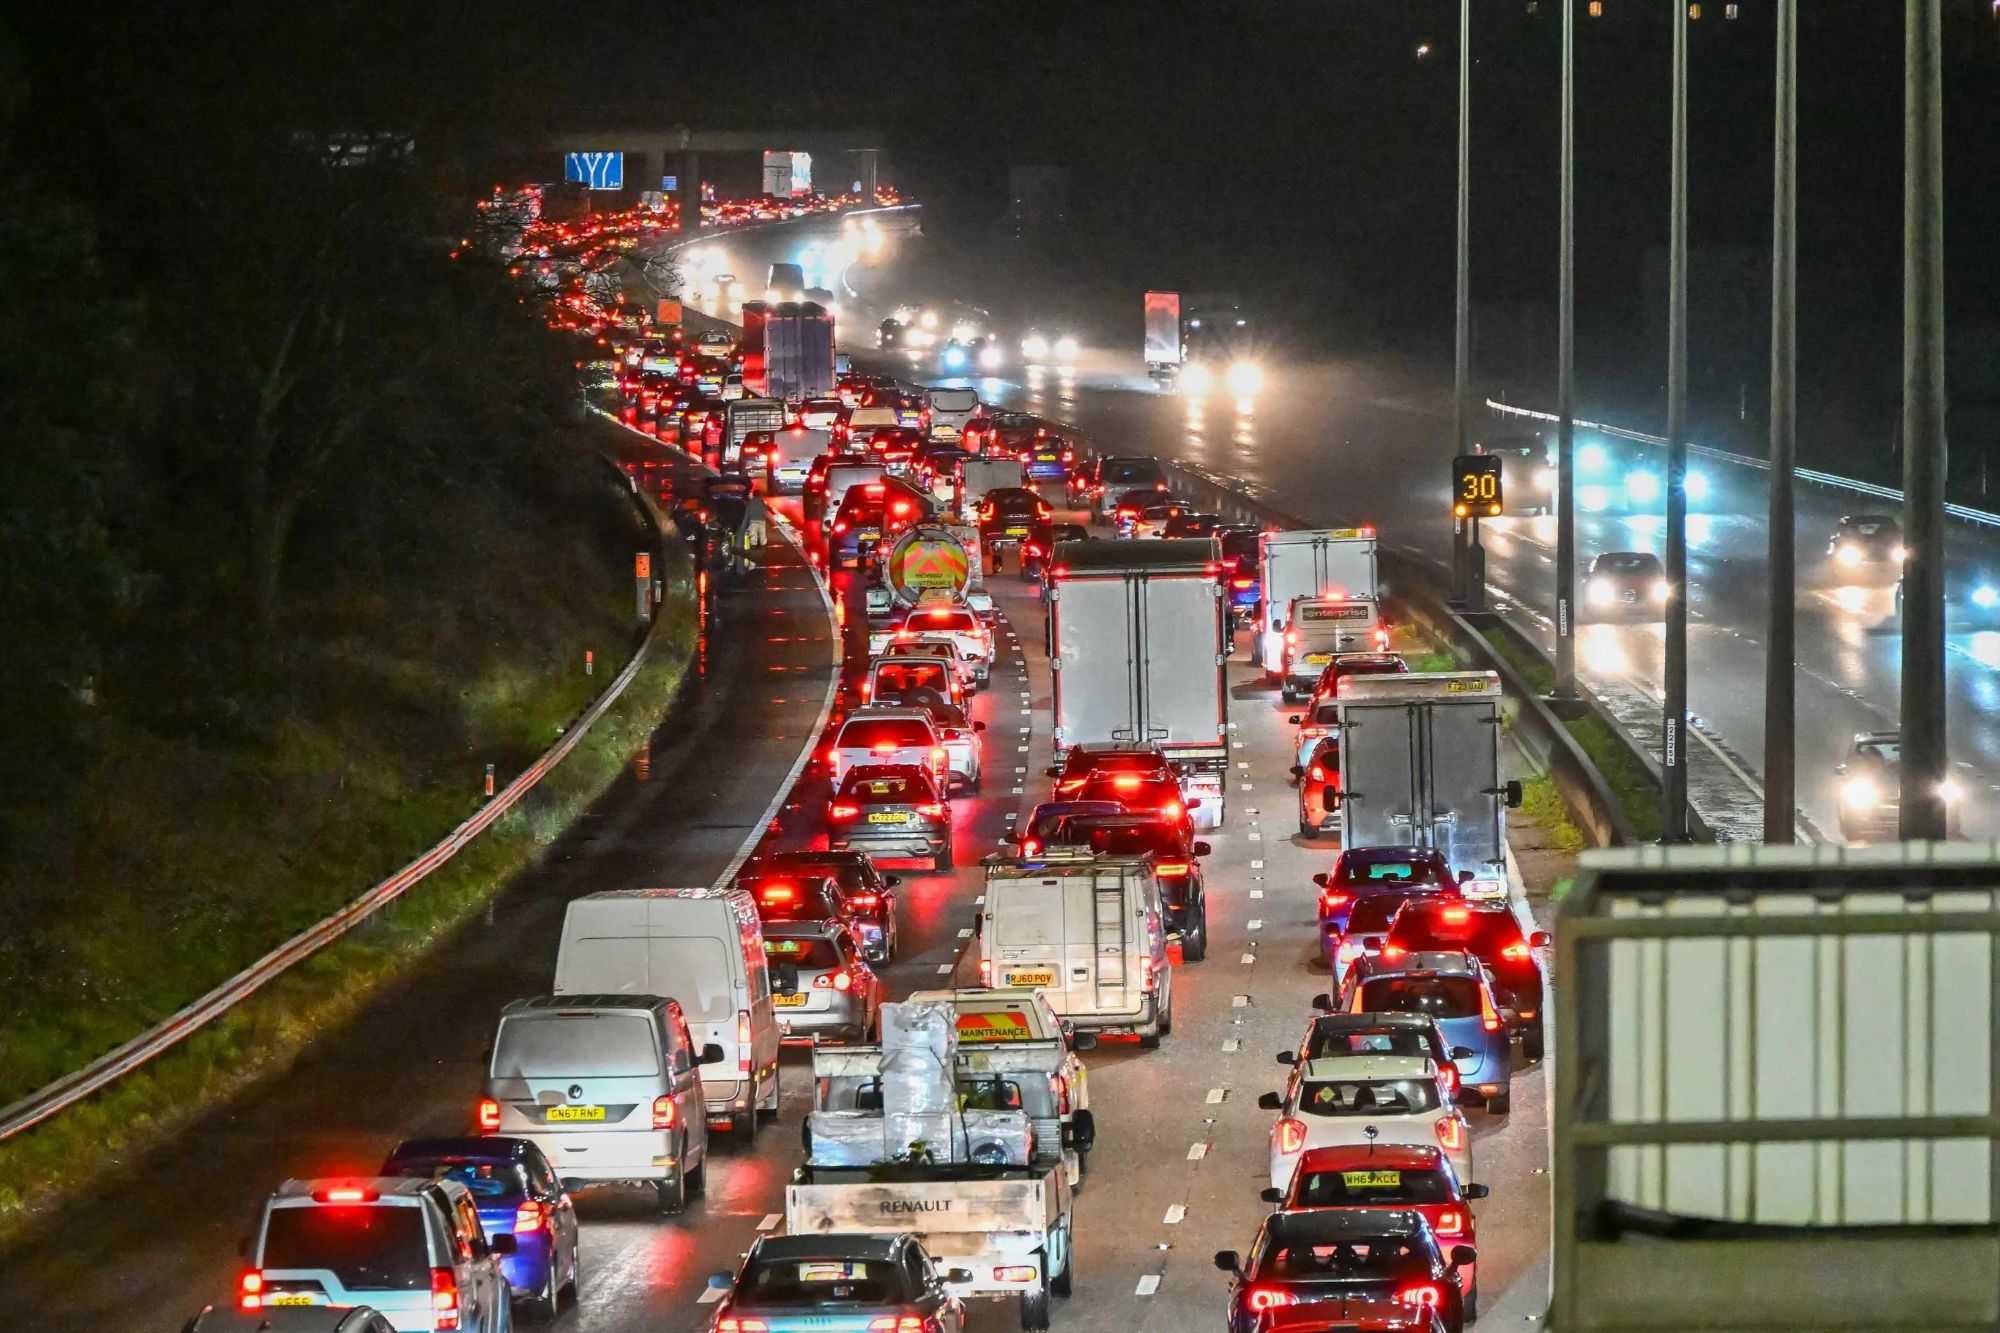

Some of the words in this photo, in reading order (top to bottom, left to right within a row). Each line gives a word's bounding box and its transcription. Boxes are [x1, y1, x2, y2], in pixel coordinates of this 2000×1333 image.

[1463, 474, 1496, 499] 30
[1303, 608, 1367, 618] enterprise
[1010, 974, 1033, 983] RJ60
[1034, 974, 1052, 983] POV
[960, 1027, 1026, 1037] MAINTENANCE
[551, 1109, 578, 1119] GN67
[580, 1109, 600, 1118] RNF
[1376, 1174, 1397, 1184] KCC
[880, 1200, 952, 1213] RENAULT
